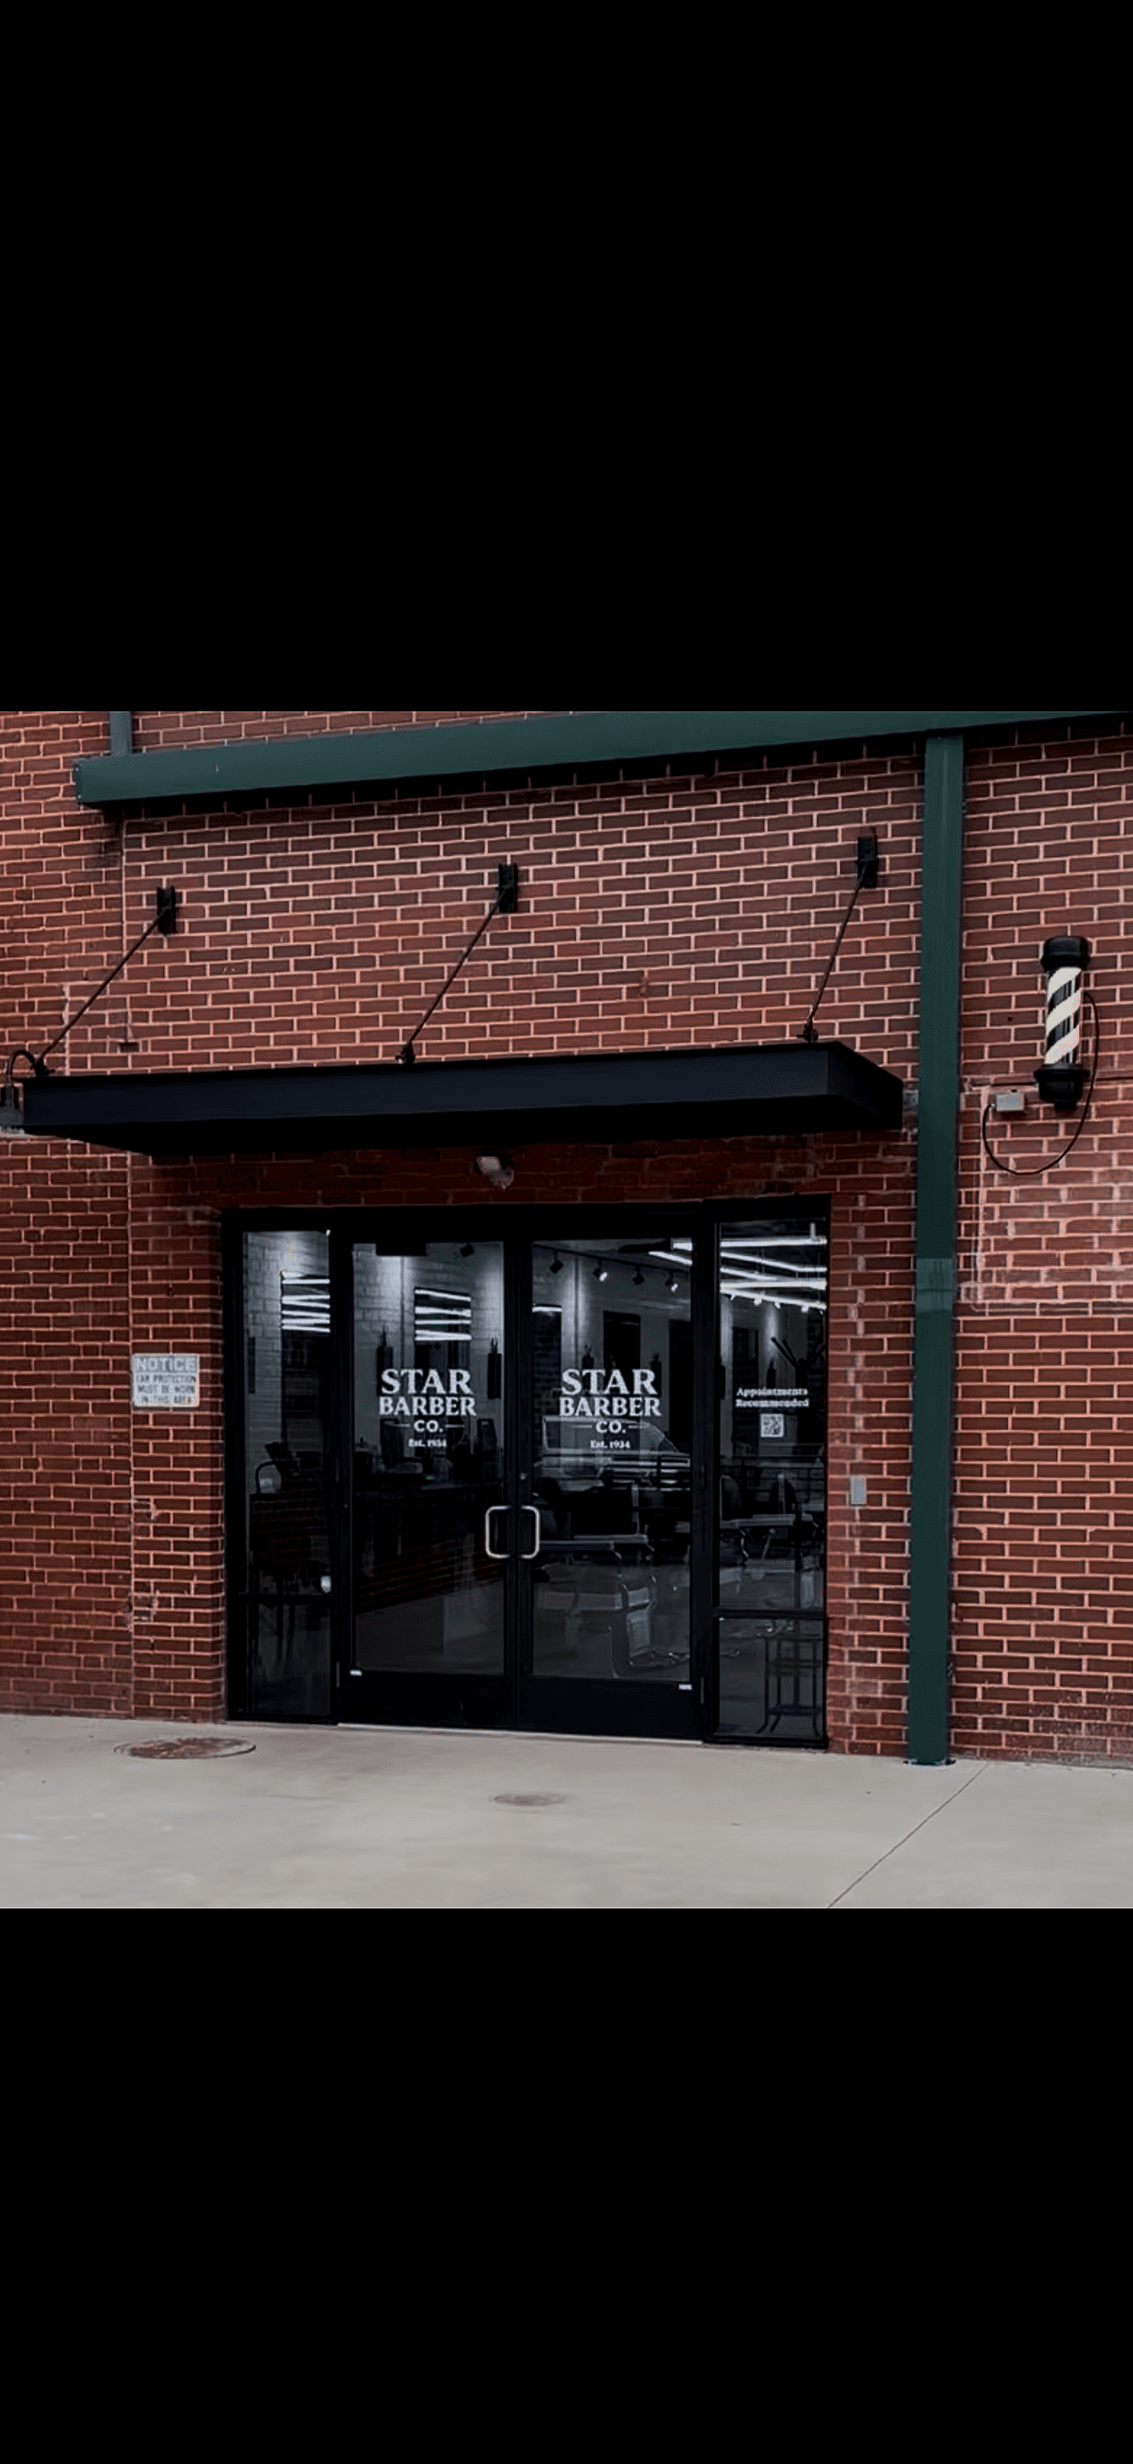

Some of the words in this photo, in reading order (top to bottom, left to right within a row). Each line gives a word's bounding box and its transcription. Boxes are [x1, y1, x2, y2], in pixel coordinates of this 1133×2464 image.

[136, 1357, 196, 1371] NOTICE
[381, 1368, 474, 1395] STAR
[561, 1368, 658, 1395] STAR
[736, 1387, 808, 1398] Appointments
[379, 1396, 477, 1416] BARBER
[559, 1396, 662, 1417] BARBER
[735, 1398, 810, 1407] Recommended
[413, 1419, 444, 1433] CO.
[595, 1420, 626, 1434] CO.
[590, 1440, 608, 1448] Est.
[609, 1440, 631, 1448] 1934
